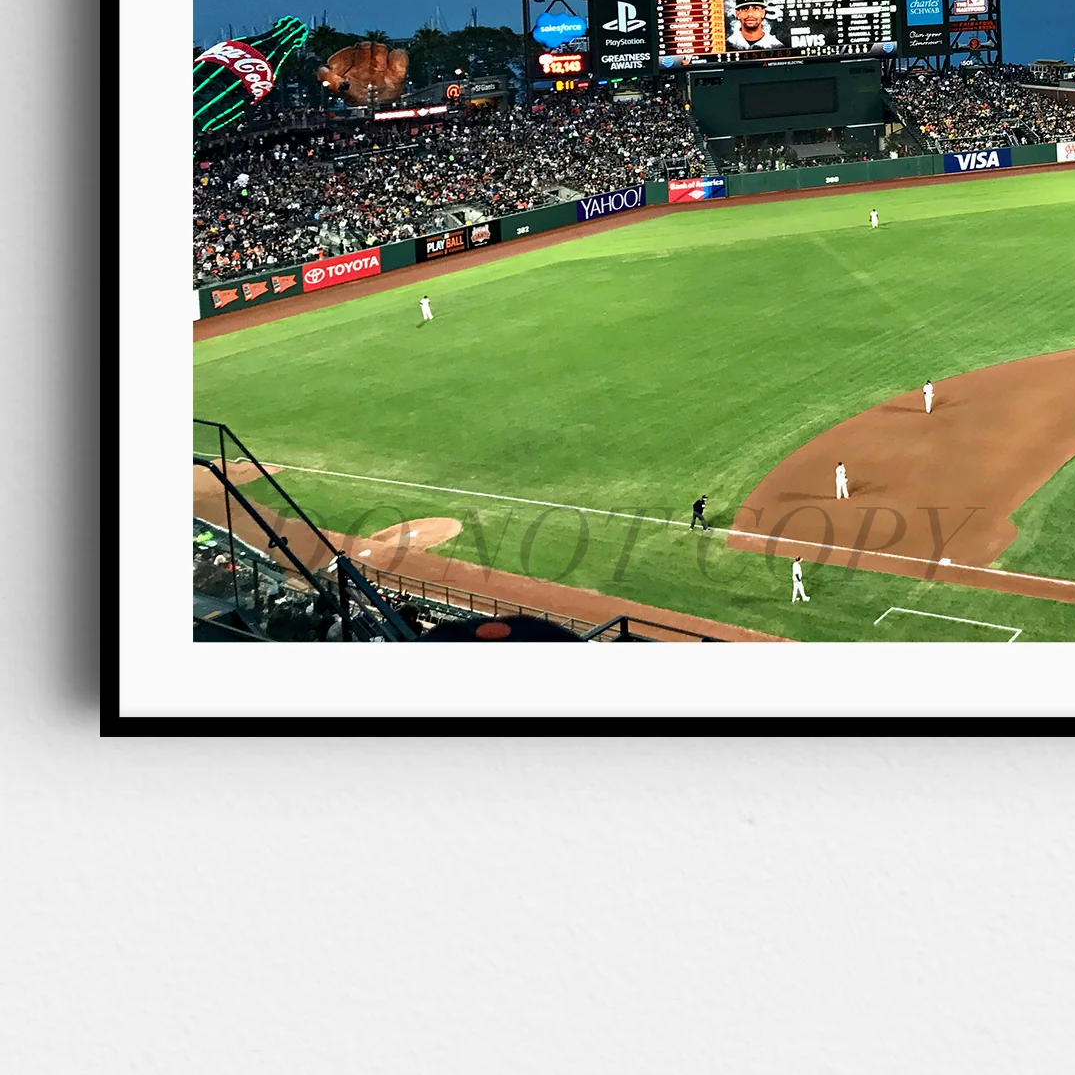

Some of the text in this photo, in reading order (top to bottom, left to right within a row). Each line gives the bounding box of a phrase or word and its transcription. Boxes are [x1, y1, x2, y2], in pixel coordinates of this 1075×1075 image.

[909, 7, 940, 15] SCHWAB
[540, 24, 582, 33] salesforce
[791, 34, 826, 48] DAVIS
[601, 53, 651, 63] GREATNESS
[954, 151, 1000, 170] VISA
[695, 179, 724, 187] America
[580, 186, 642, 220] YAHOO!
[426, 240, 446, 253] PLAY
[445, 235, 464, 248] BALL
[326, 256, 379, 278] TOYOTA
